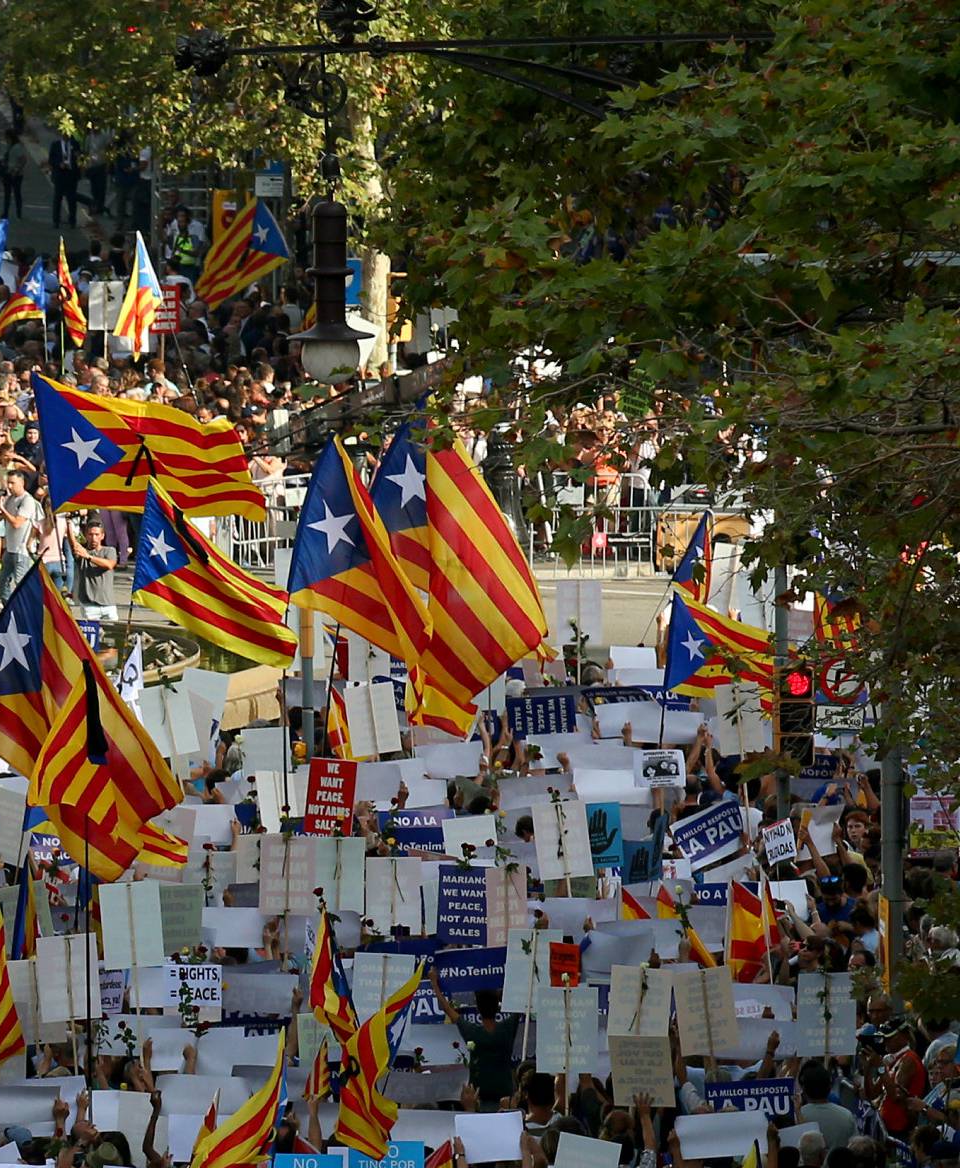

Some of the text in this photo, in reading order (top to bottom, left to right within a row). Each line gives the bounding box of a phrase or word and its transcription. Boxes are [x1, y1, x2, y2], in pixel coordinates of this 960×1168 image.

[525, 714, 533, 734] ARM
[327, 763, 340, 774] WE
[320, 777, 344, 789] WANT
[307, 804, 325, 816] NOT
[314, 819, 342, 831] SALE
[393, 816, 437, 827] NO A LA
[682, 807, 739, 839] MILLOR RESPOSTA
[706, 814, 744, 846] PAU
[42, 837, 60, 847] NO
[397, 841, 445, 852] NoTenim
[443, 888, 458, 898] WE
[713, 890, 722, 899] A
[448, 902, 484, 912] PEACE,
[440, 915, 460, 923] NOT
[448, 928, 481, 937] SALES
[440, 964, 507, 979] #NoTenim
[708, 1086, 789, 1098] LA MILLOR RESPOSTA
[743, 1095, 790, 1116] PAU
